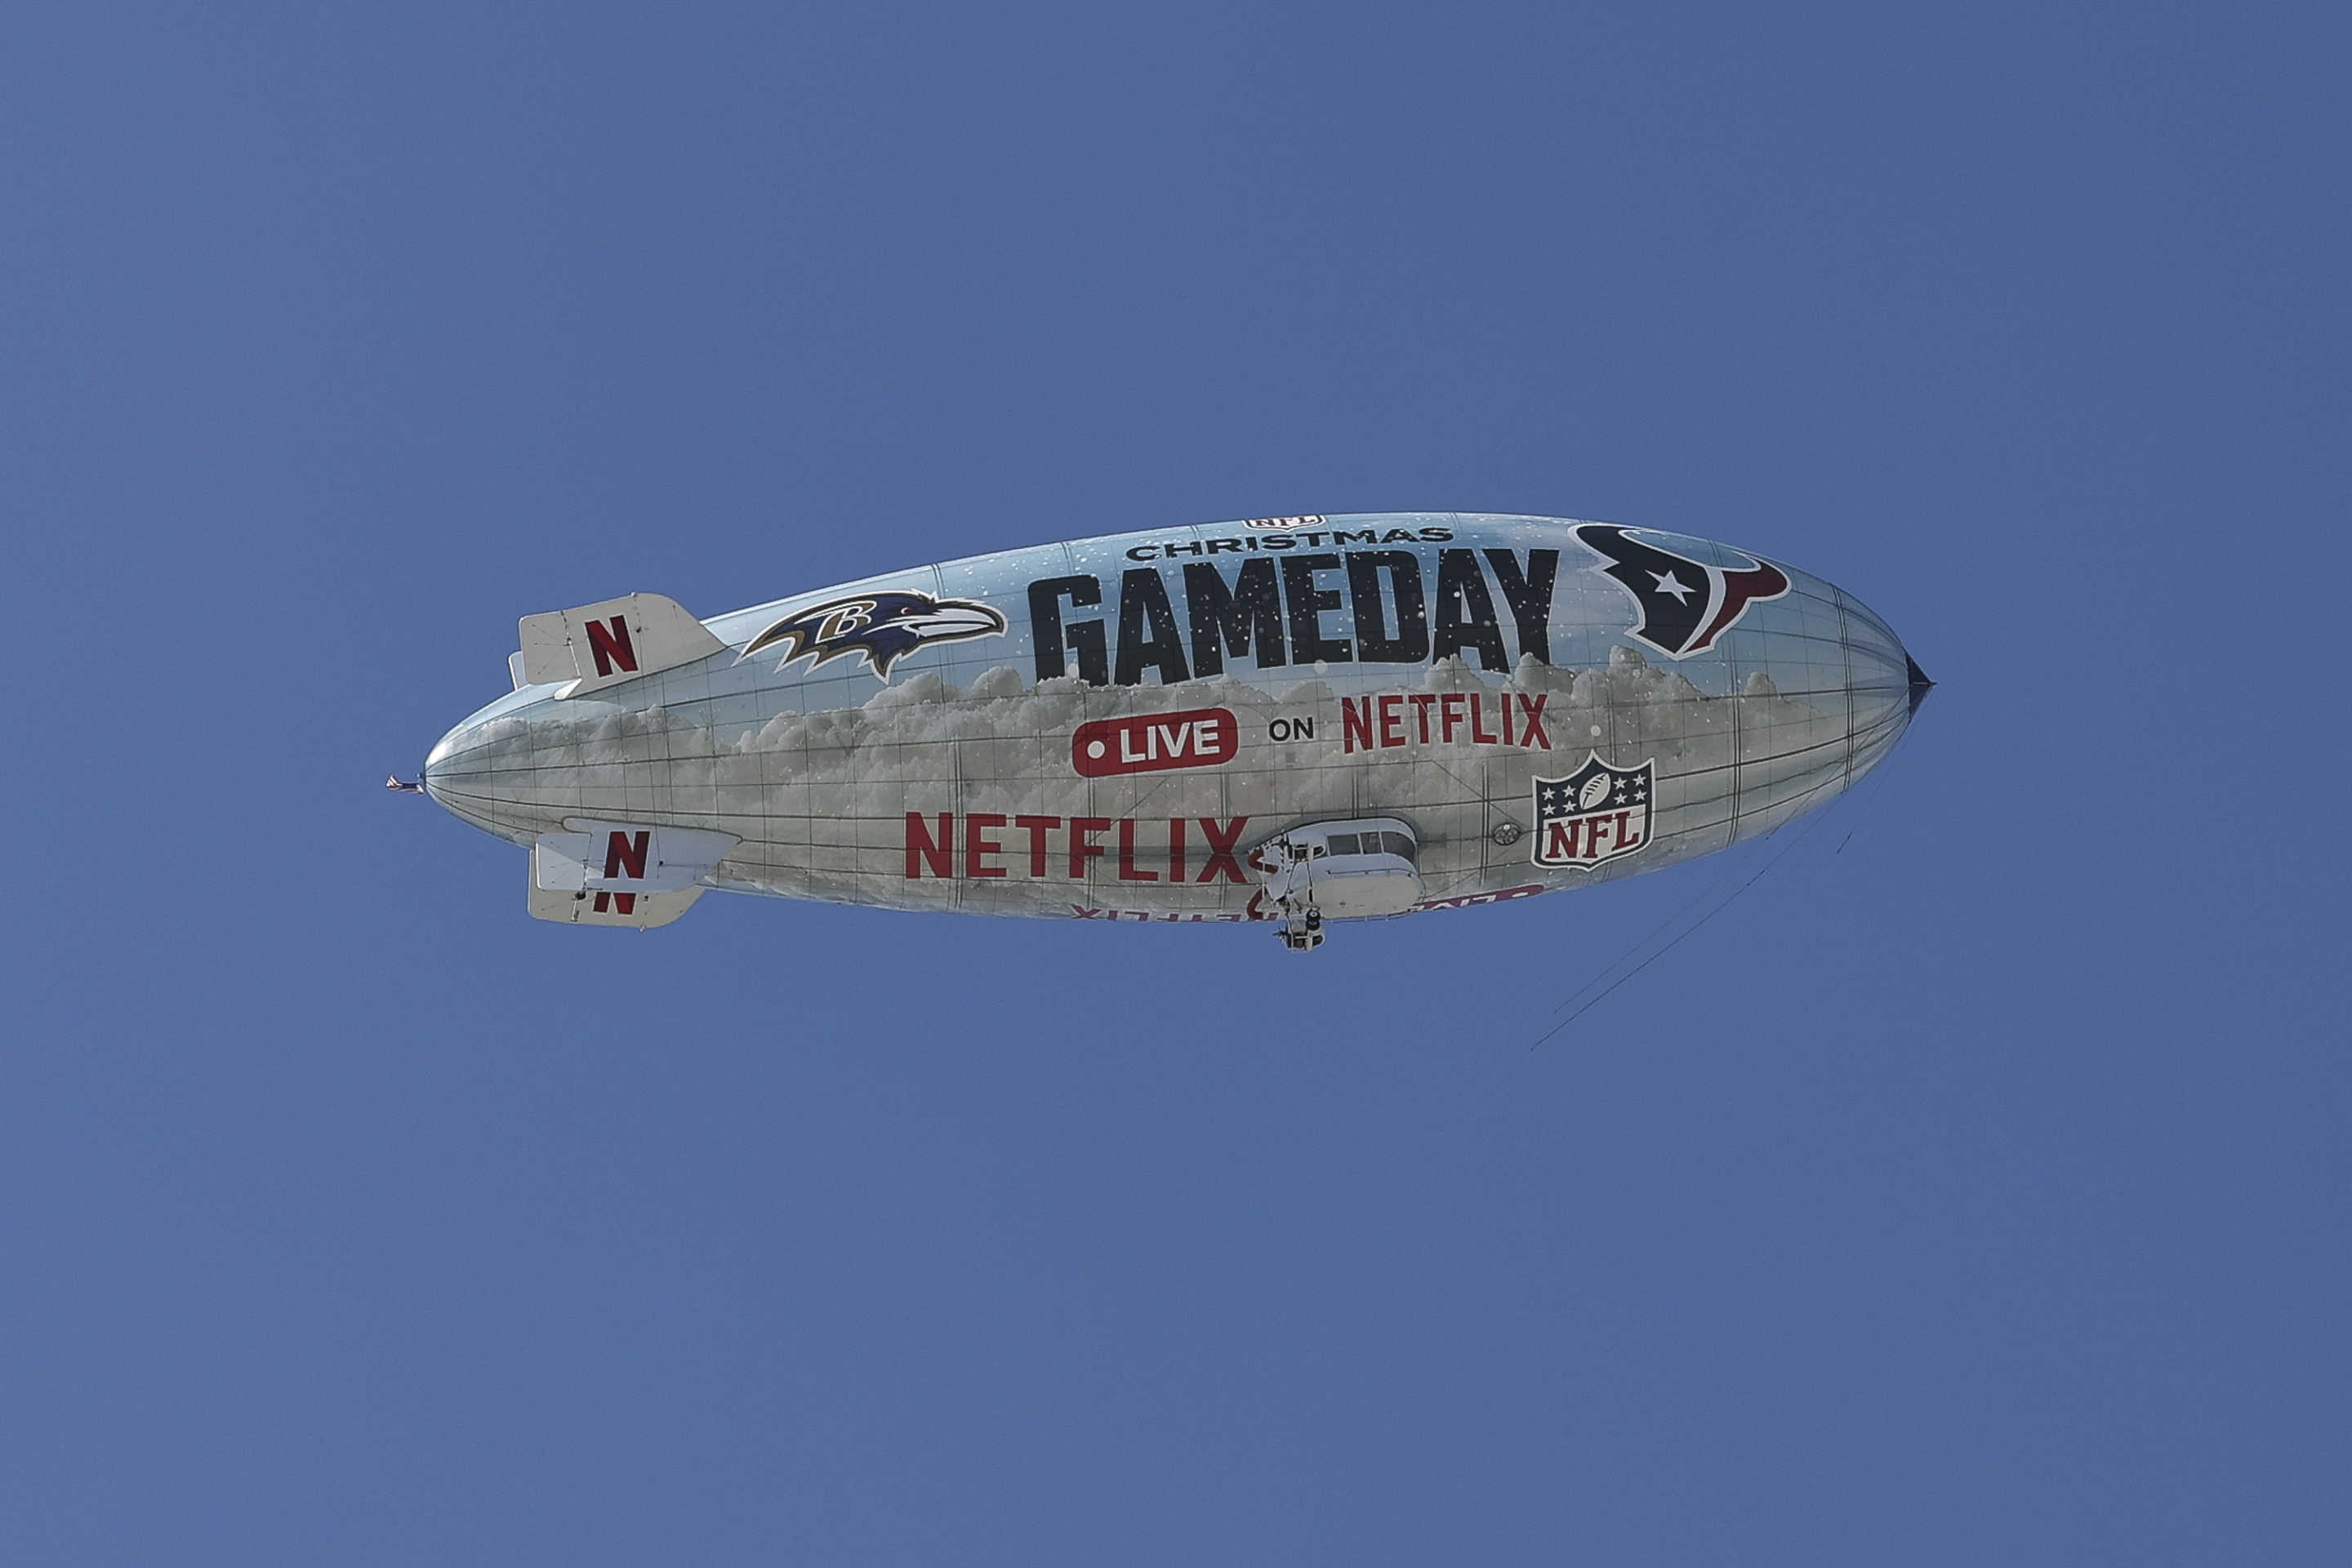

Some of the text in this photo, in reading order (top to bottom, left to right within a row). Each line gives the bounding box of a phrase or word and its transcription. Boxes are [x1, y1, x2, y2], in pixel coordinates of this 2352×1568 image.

[1125, 528, 1454, 562] CHRISTMAS
[815, 601, 877, 644] B
[1028, 548, 1560, 686] GAMEDAY
[585, 616, 639, 677] N
[1120, 693, 1551, 762] LIVE ON NETFLIX
[604, 831, 650, 879] N
[905, 812, 1250, 884] NETFLIX
[1545, 812, 1640, 859] NFL
